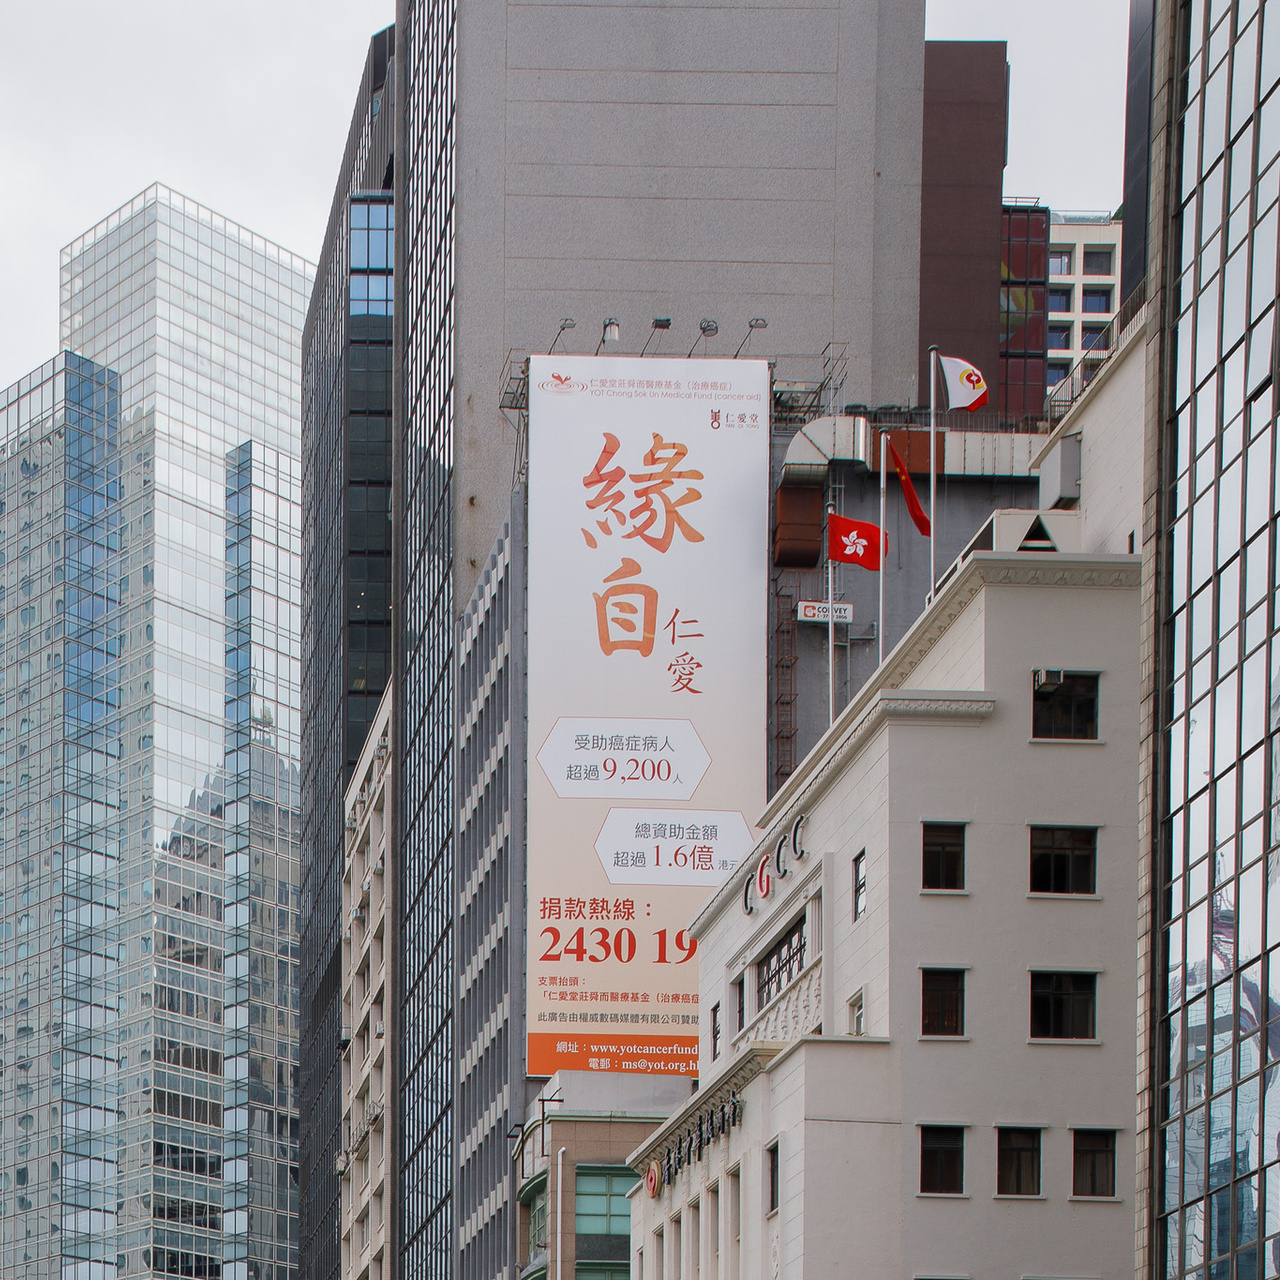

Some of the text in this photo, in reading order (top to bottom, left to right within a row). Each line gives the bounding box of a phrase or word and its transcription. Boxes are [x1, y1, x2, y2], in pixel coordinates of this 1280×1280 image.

[589, 389, 605, 397] YOT
[606, 389, 633, 399] Chong
[634, 389, 648, 398] Sok
[649, 390, 660, 398] Un
[661, 390, 693, 399] Medical
[694, 391, 713, 400] Fund
[574, 734, 675, 752] 受助癌症病人
[634, 822, 719, 842] 總資助金額
[538, 926, 637, 964] 2430
